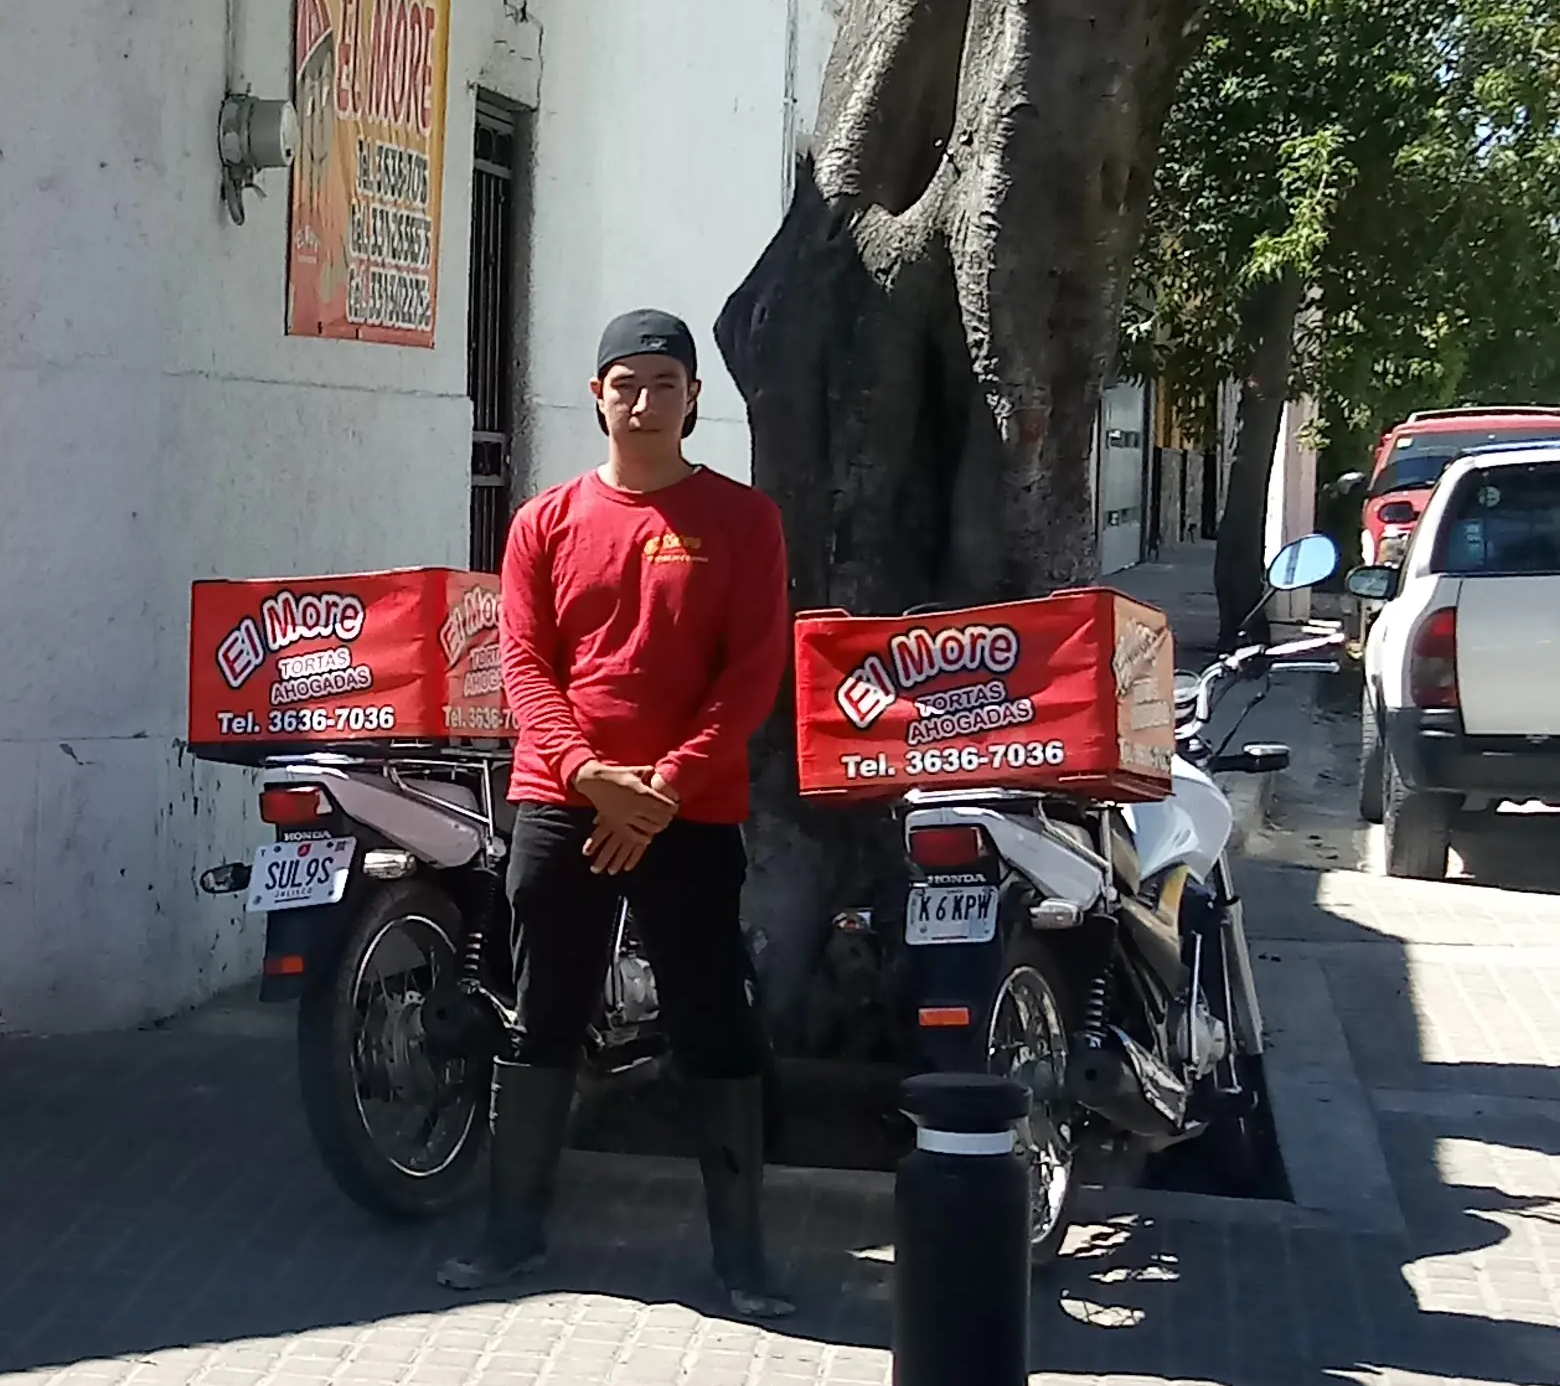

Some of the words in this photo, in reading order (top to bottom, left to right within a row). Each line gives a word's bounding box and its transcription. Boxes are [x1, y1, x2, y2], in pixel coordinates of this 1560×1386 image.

[262, 591, 365, 651] More
[278, 648, 352, 680] TORTAS
[890, 623, 1019, 689] More
[270, 665, 373, 705] AHOGADAS
[915, 681, 1007, 717] TORTAS
[217, 712, 260, 734] Tel.
[268, 706, 394, 733] 3636-7036
[908, 698, 1034, 745] AHOGADAS
[841, 755, 896, 779] Tel.
[906, 740, 1064, 775] 3636-7036
[284, 830, 332, 842] HONDA
[265, 856, 334, 890] SUL9S
[927, 873, 986, 884] HONDA
